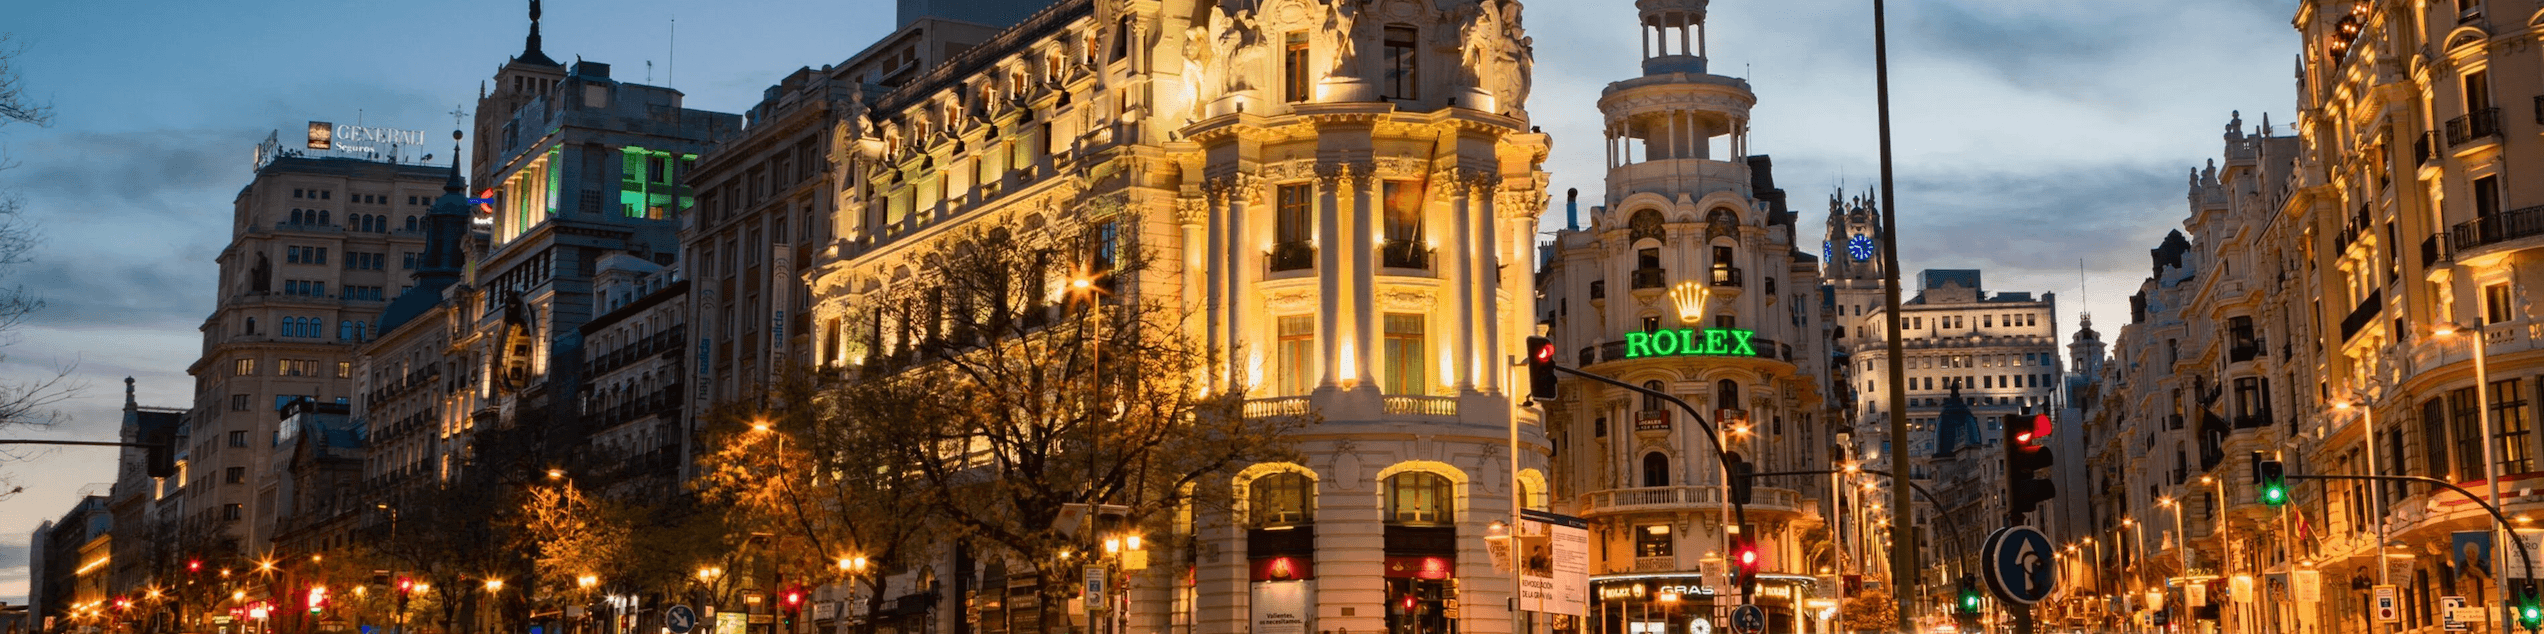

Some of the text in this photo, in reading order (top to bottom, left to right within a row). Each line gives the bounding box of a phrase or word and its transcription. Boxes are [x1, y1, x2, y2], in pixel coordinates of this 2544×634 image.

[336, 124, 425, 146] GENERALI
[335, 141, 375, 153] Seguros
[772, 310, 785, 349] salida
[1625, 328, 1756, 358] ROLEX
[699, 338, 711, 374] salida
[1522, 579, 1553, 589] REMODELACIÓN
[1534, 591, 1545, 600] GRAN
[2443, 599, 2460, 618] P
